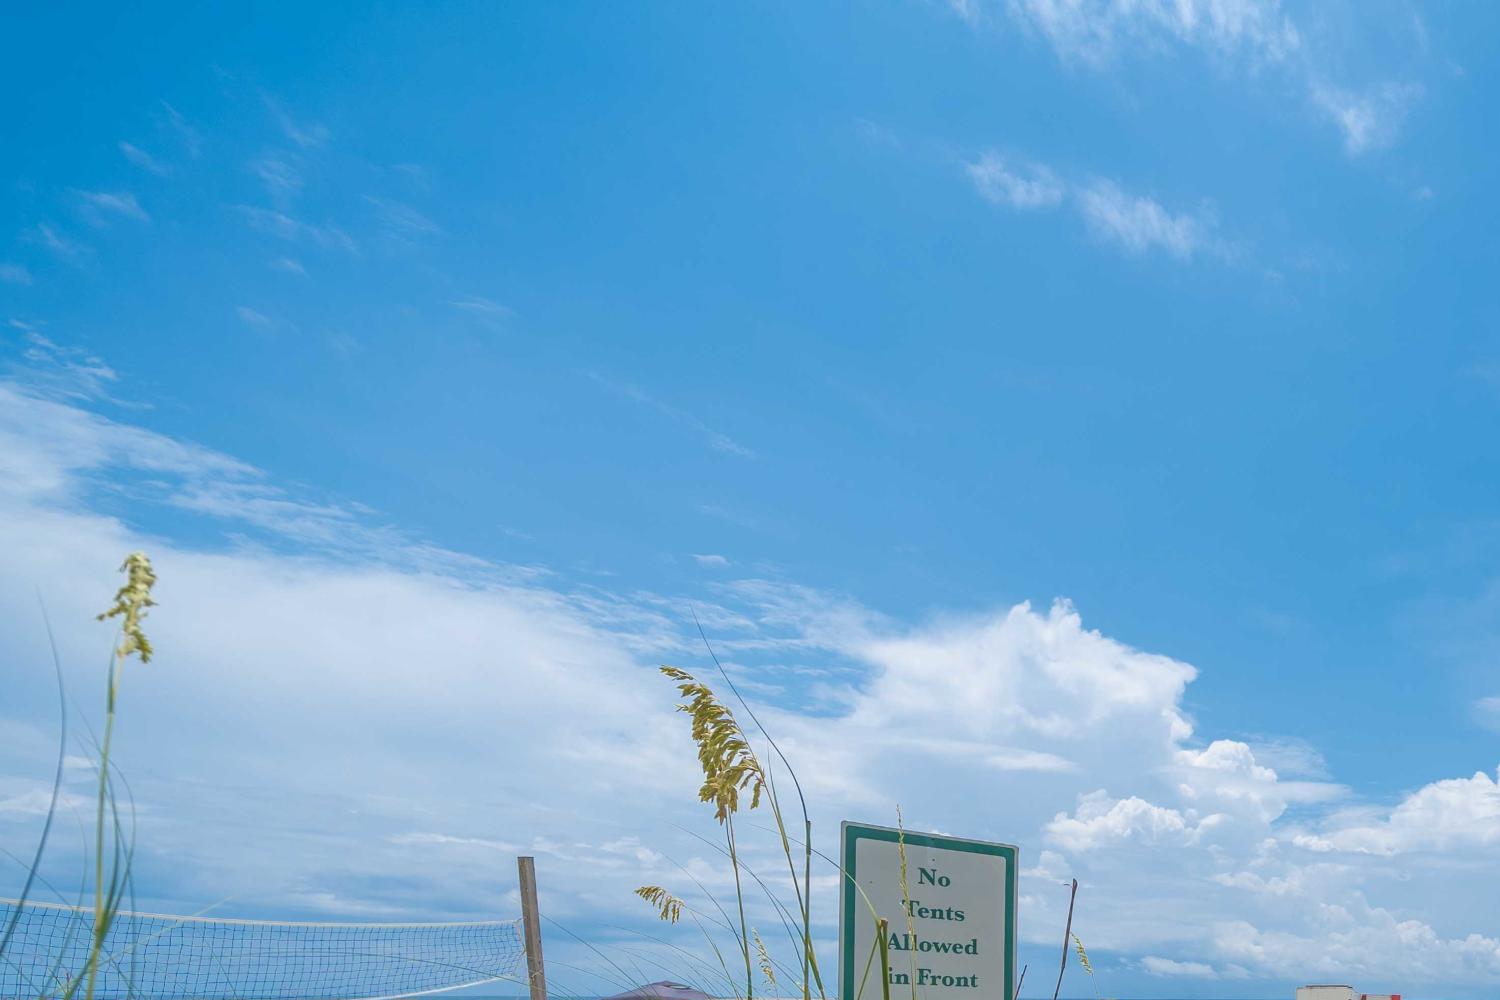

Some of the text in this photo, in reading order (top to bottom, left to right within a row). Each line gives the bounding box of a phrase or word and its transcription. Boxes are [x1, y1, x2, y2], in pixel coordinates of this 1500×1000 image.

[918, 867, 951, 887] No
[902, 900, 966, 922] Tents
[888, 932, 979, 955] Allowed
[889, 966, 979, 988] in Front
